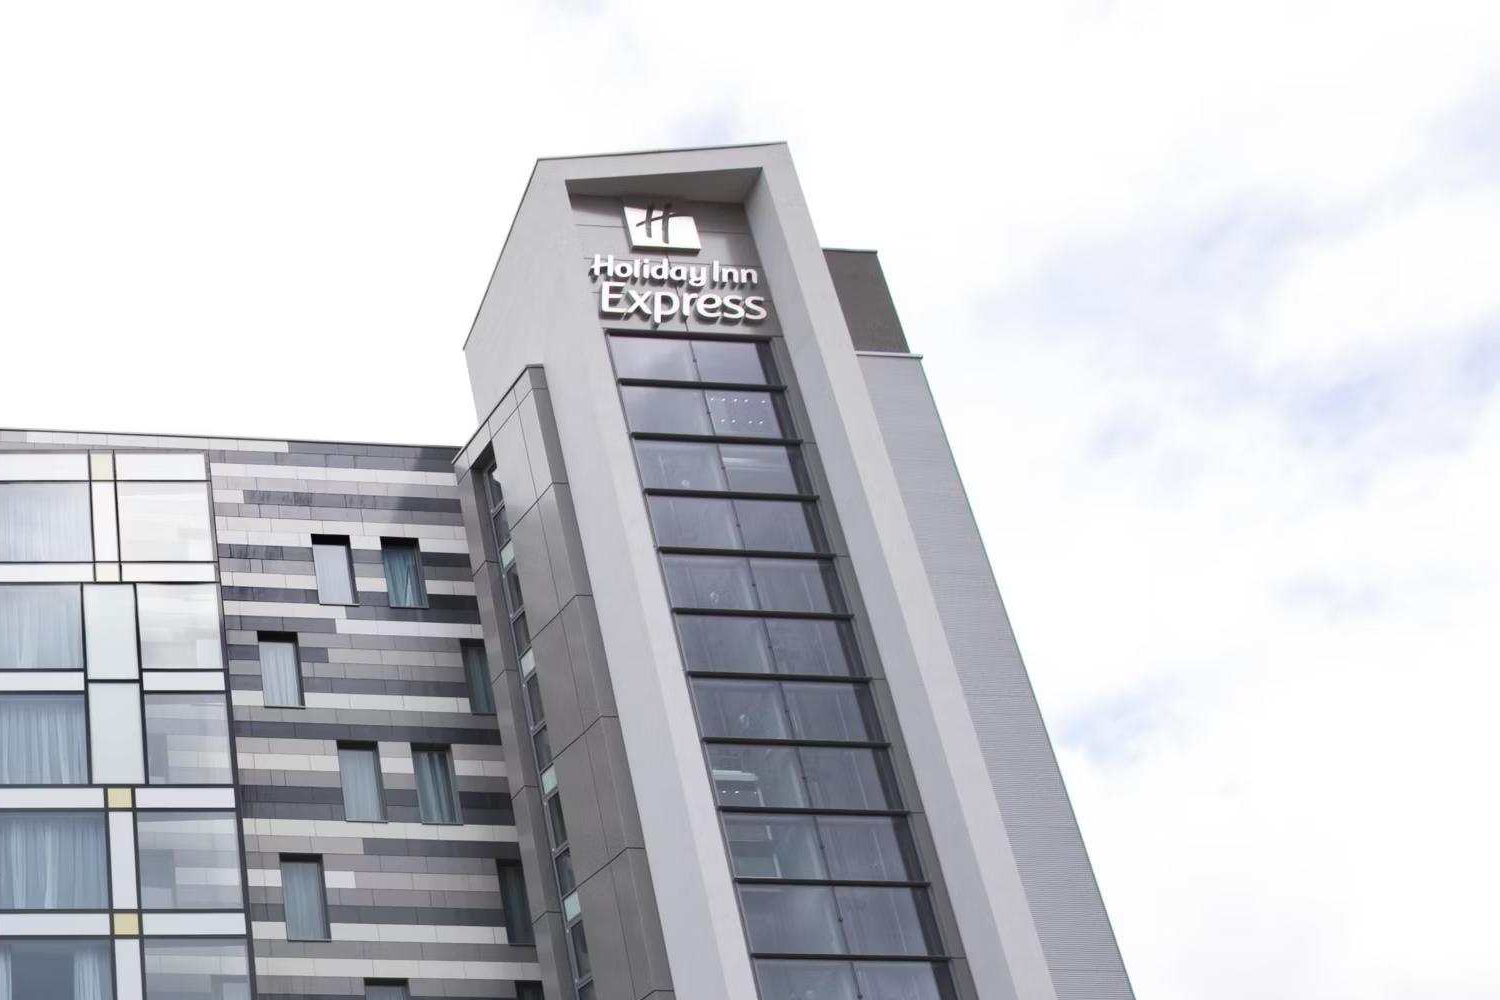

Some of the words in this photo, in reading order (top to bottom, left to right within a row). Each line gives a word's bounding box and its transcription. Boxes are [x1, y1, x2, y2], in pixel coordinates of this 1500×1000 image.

[590, 254, 707, 287] Holiday
[712, 260, 758, 284] Inn
[601, 281, 768, 324] Express
